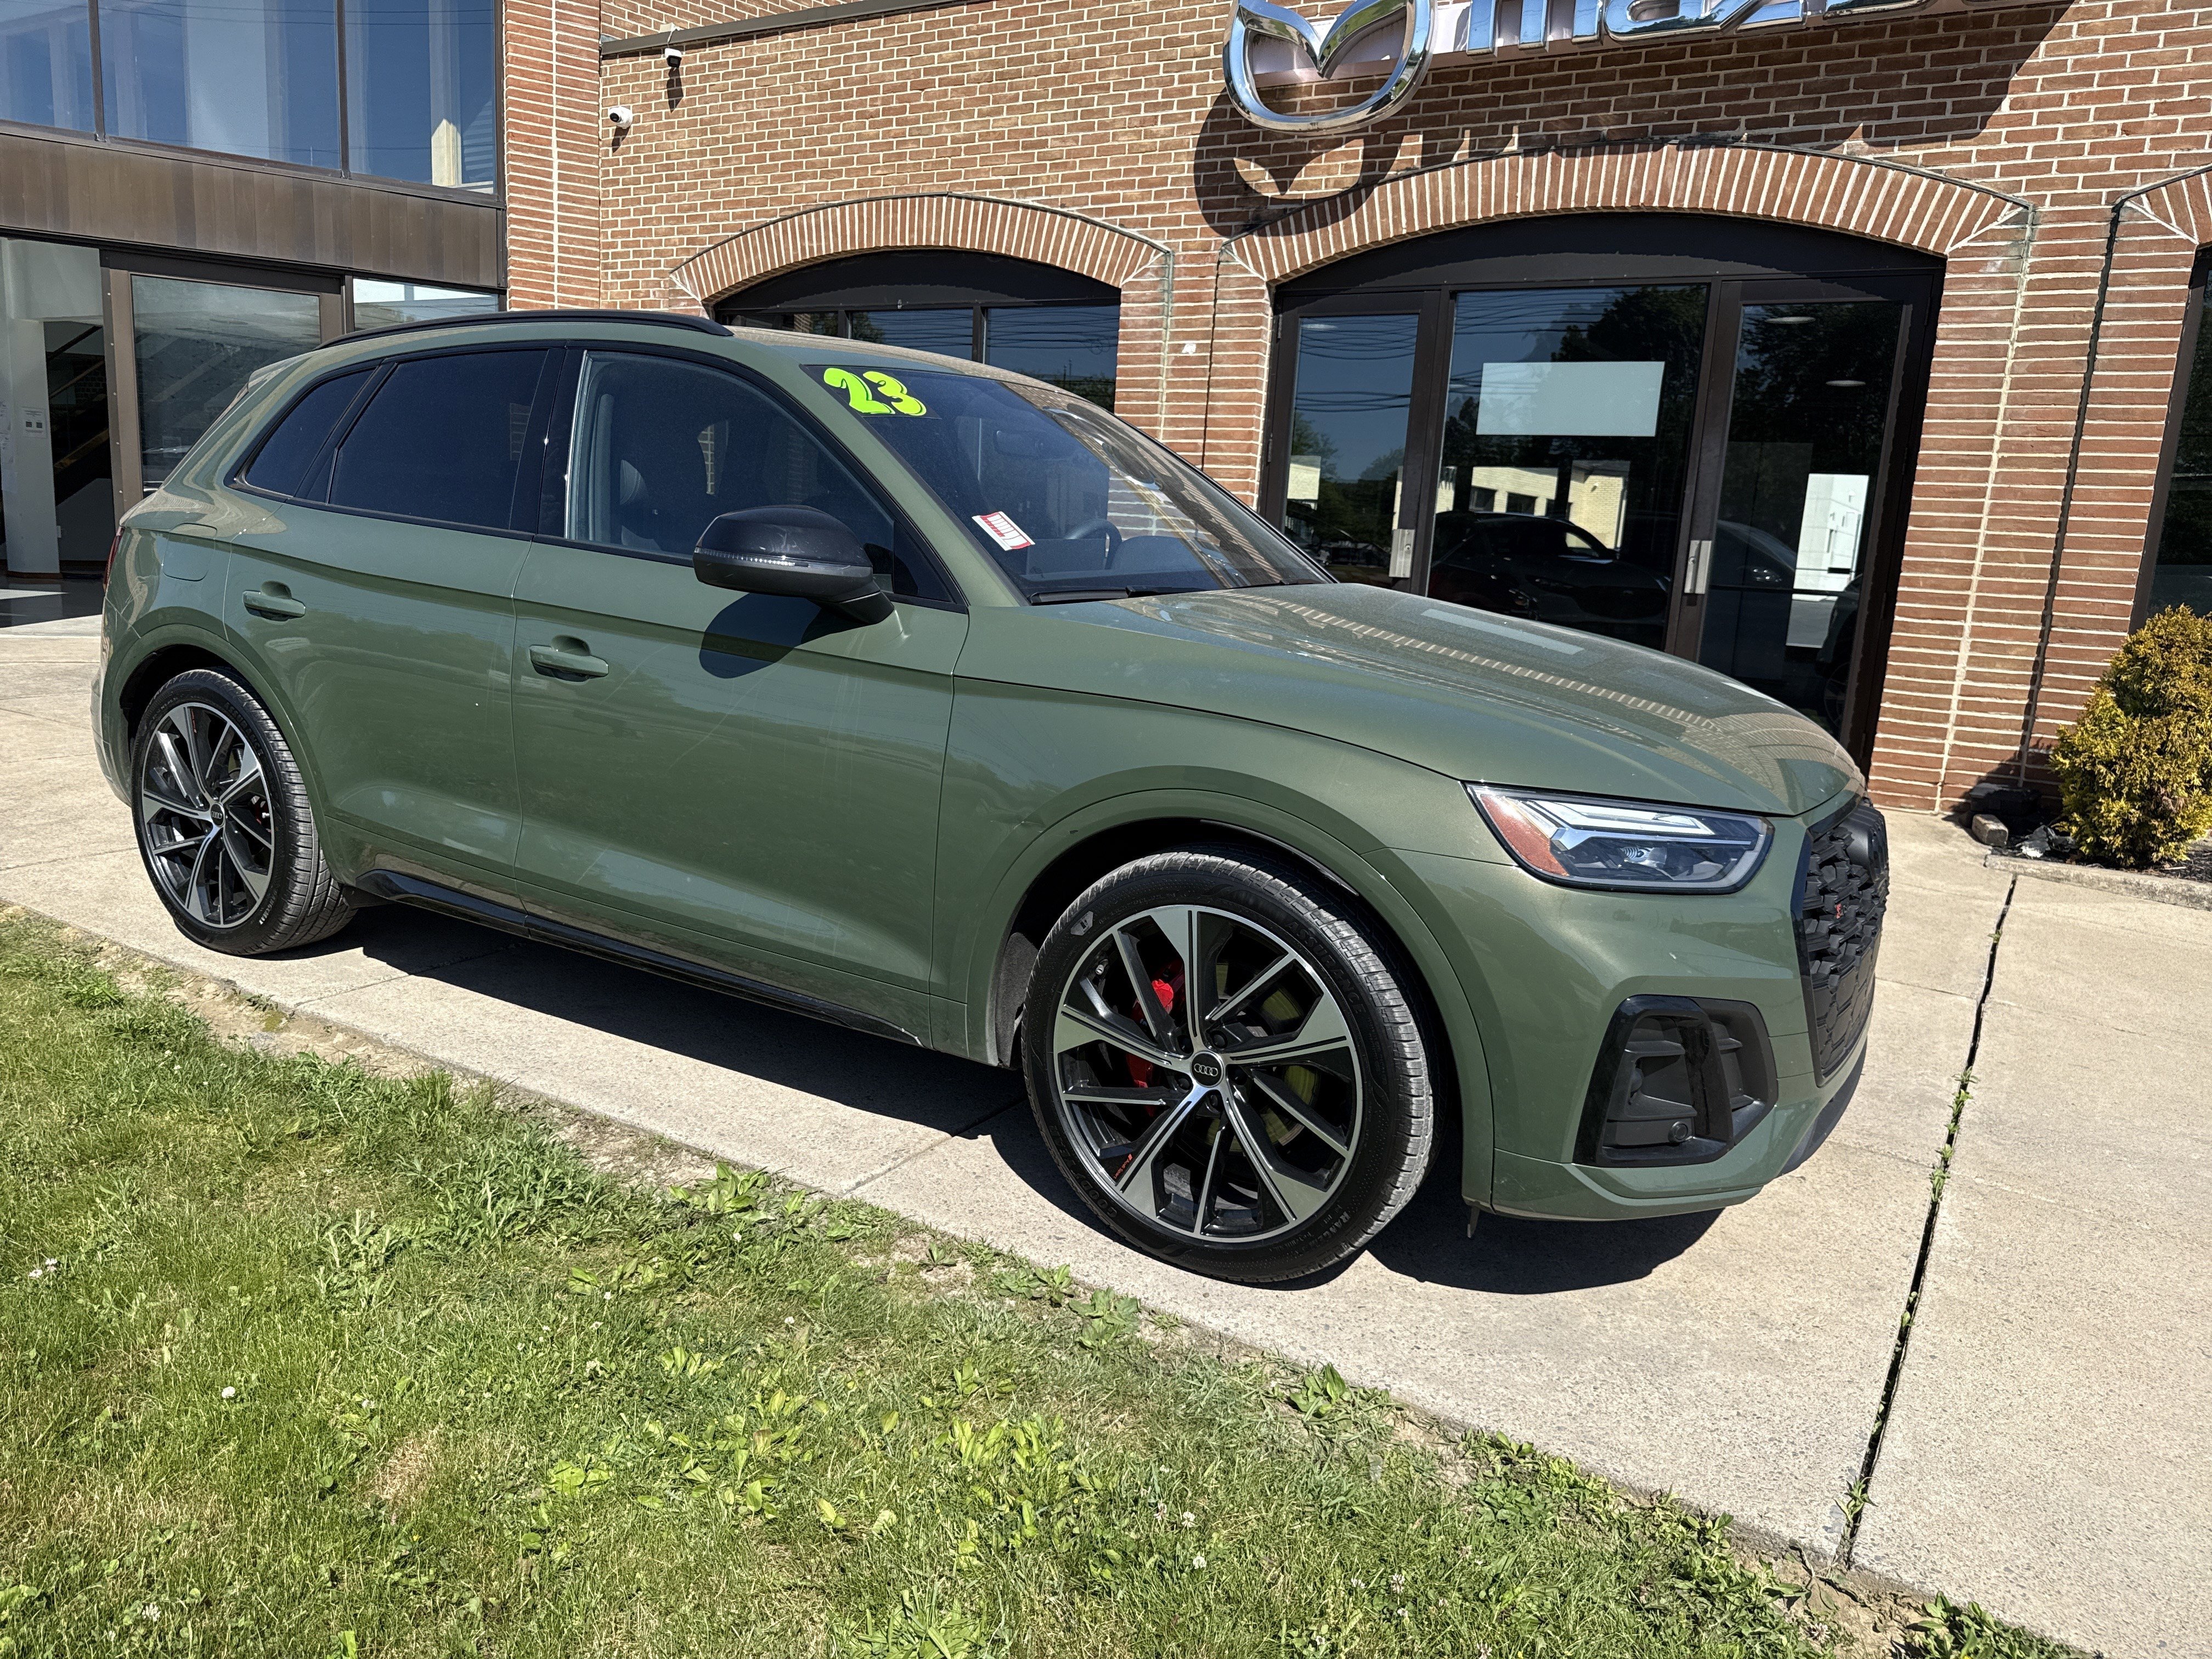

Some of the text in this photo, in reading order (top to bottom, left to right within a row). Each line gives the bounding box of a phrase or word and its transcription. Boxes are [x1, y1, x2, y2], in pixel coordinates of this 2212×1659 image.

[823, 368, 927, 416] 23
[1283, 922, 1366, 1014] ASSURANCE
[1048, 1125, 1118, 1218] GOODYEAR
